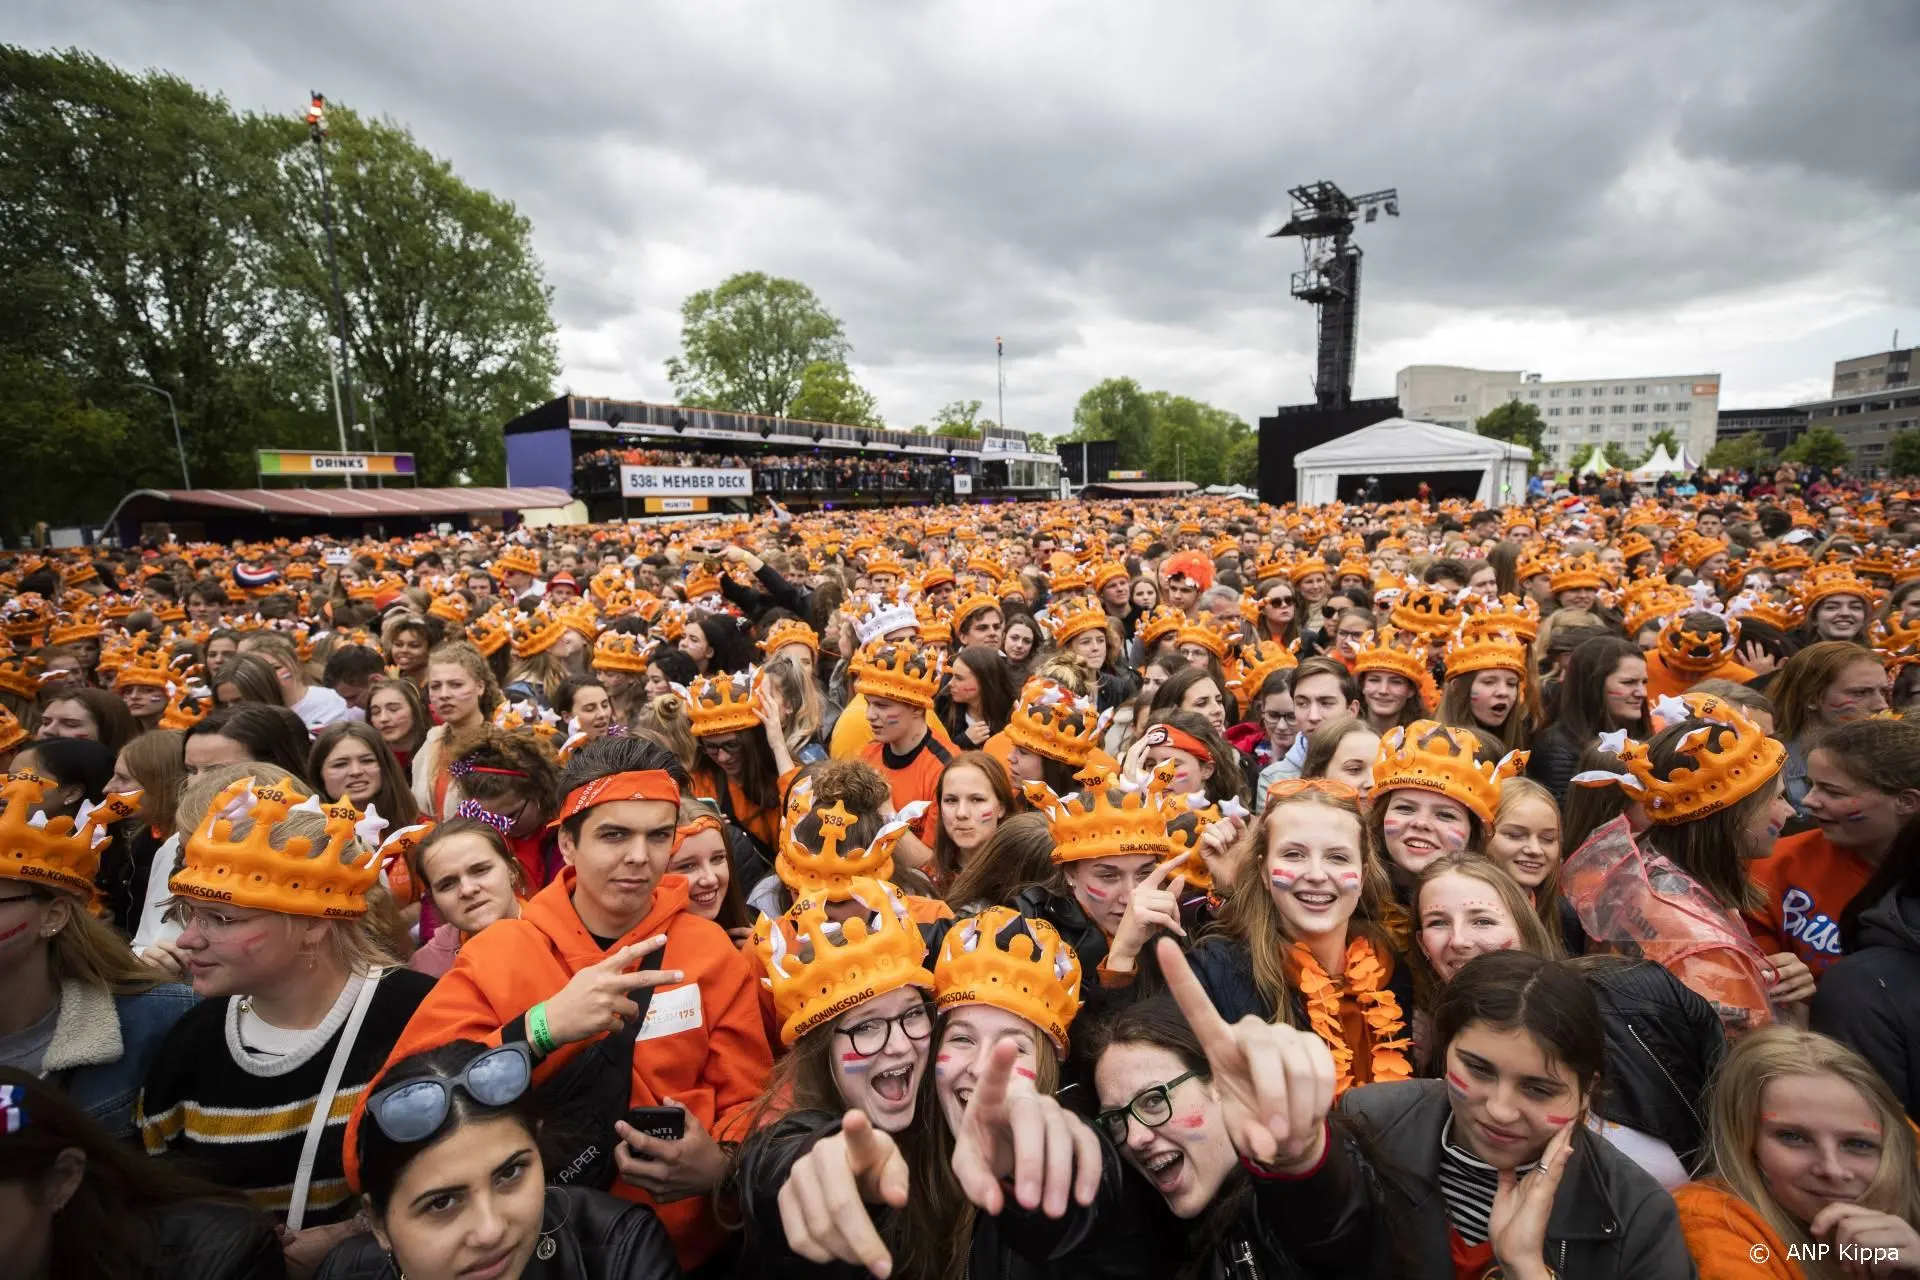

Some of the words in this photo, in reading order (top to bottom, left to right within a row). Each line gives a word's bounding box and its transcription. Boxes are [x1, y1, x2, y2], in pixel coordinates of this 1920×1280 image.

[315, 458, 364, 468] DRINKS
[631, 474, 652, 488] 538
[662, 475, 714, 488] MEMBER
[719, 475, 745, 488] DECK
[1389, 777, 1446, 791] KONINGSDAG
[257, 788, 283, 802] 538
[329, 807, 355, 820] 538
[824, 814, 842, 826] 538
[20, 865, 43, 877] 538
[808, 987, 875, 1025] KONINGSDAG
[679, 1008, 695, 1019] 175
[560, 1145, 600, 1184] PAPER
